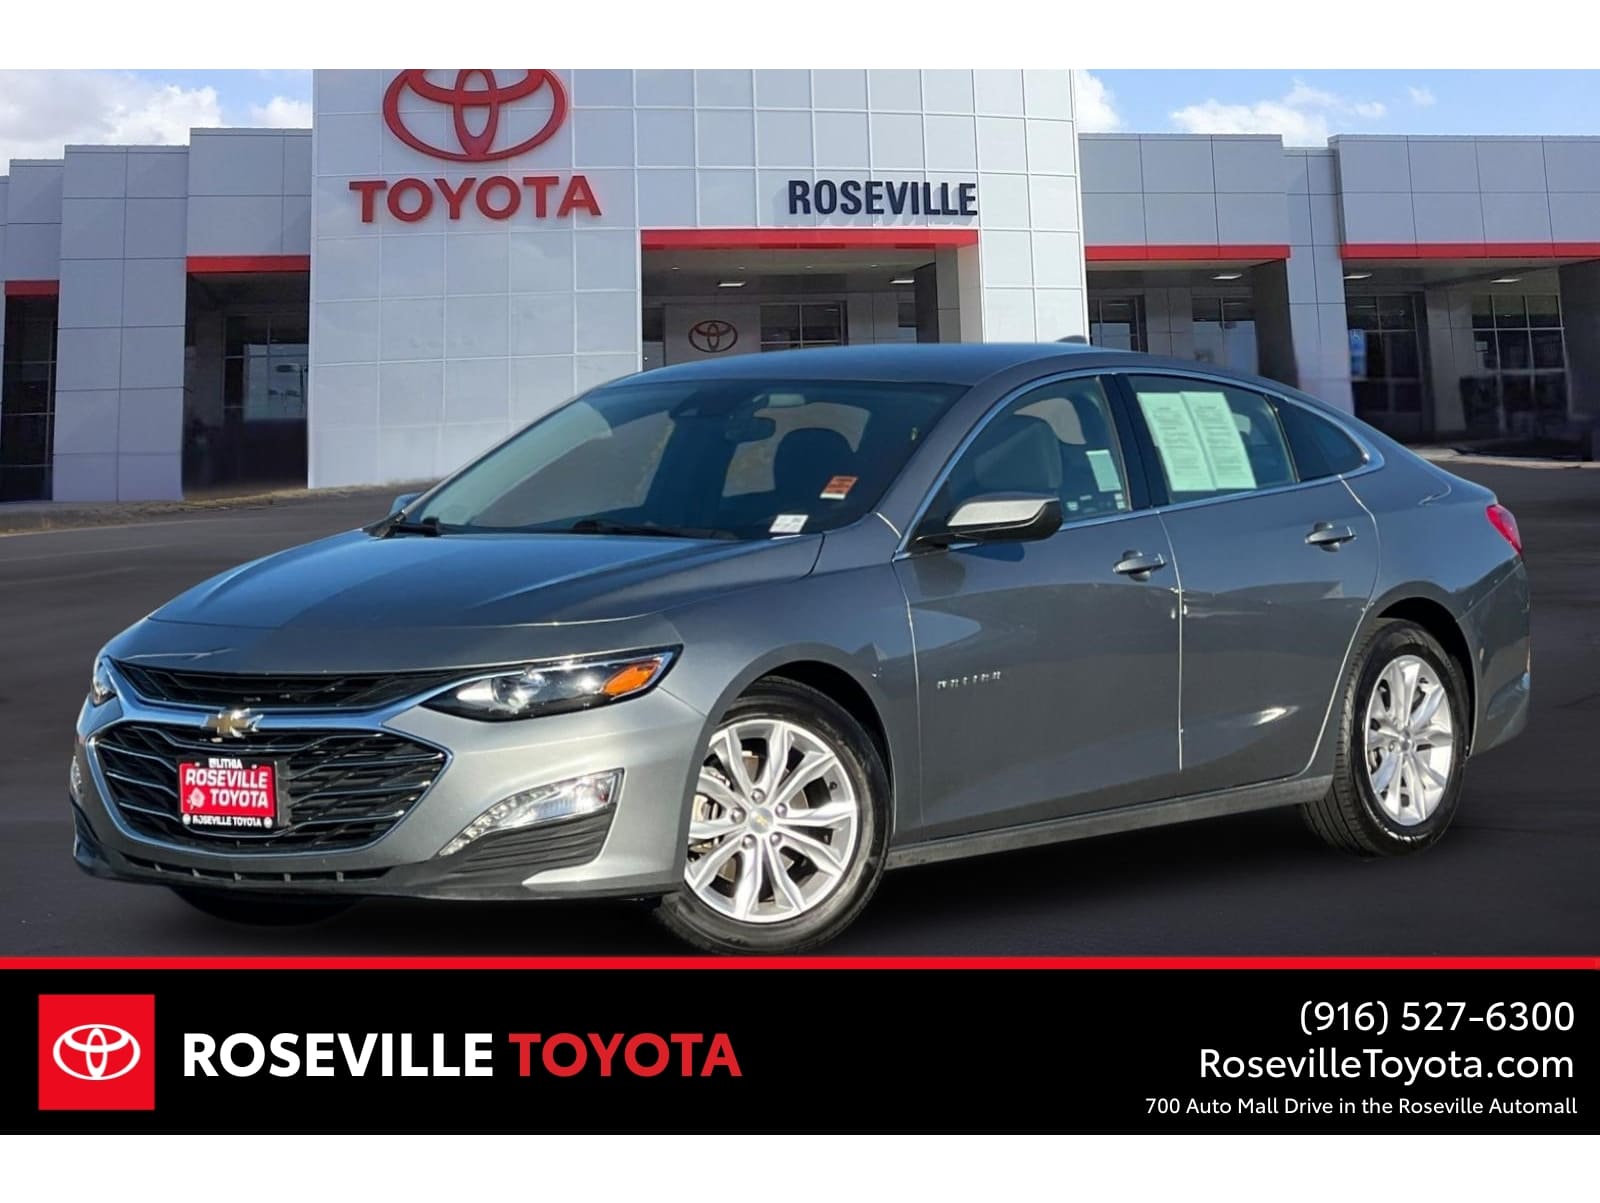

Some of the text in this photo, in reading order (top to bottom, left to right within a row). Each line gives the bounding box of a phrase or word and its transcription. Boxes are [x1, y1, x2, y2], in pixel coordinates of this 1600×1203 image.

[349, 176, 602, 223] TOYOTA
[788, 179, 978, 217] ROSEVILLE
[185, 768, 269, 789] ROSEVILLE
[209, 788, 270, 809] TOYOTA
